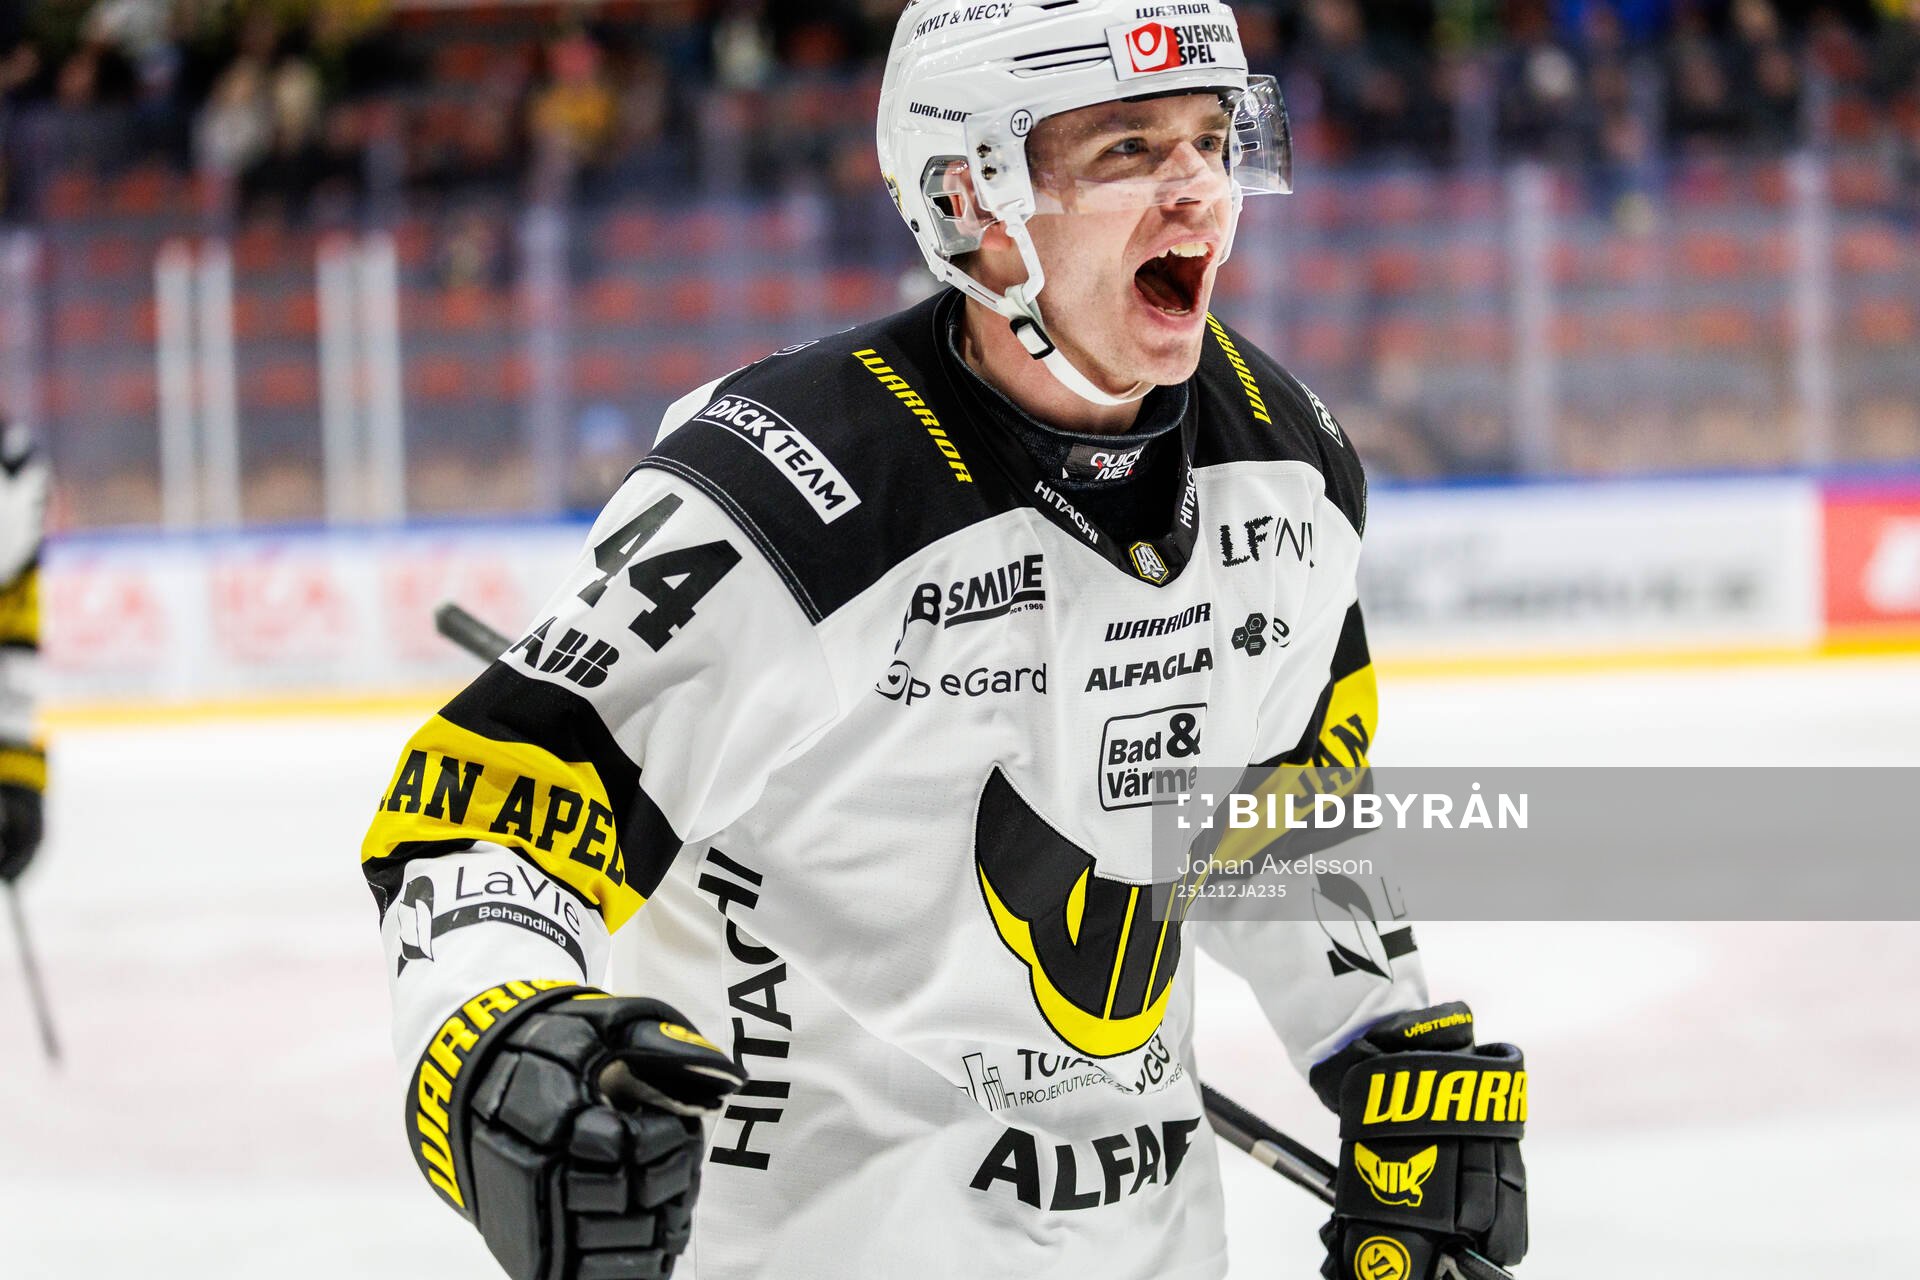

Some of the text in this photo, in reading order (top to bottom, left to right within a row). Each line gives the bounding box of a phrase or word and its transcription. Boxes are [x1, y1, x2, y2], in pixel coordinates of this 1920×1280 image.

[914, 3, 1012, 40] SKYLT & NEON
[1174, 24, 1235, 45] SVENSKA
[1178, 44, 1216, 66] SPEL
[852, 348, 973, 484] WARRIOR
[704, 400, 847, 511] DÄCK TEAM
[1090, 446, 1144, 469] QUICK
[1034, 480, 1099, 545] HITACHI
[577, 492, 743, 653] 44
[945, 554, 1044, 616] SMIDE
[1025, 603, 1044, 611] 1969
[1104, 602, 1212, 642] WARRIOR
[509, 616, 620, 688] ABB
[1108, 713, 1201, 765] Bad &
[1107, 766, 1198, 799] Värme
[455, 866, 580, 936] LaVie
[478, 905, 567, 945] Behandling
[697, 846, 793, 1171] HITACHI
